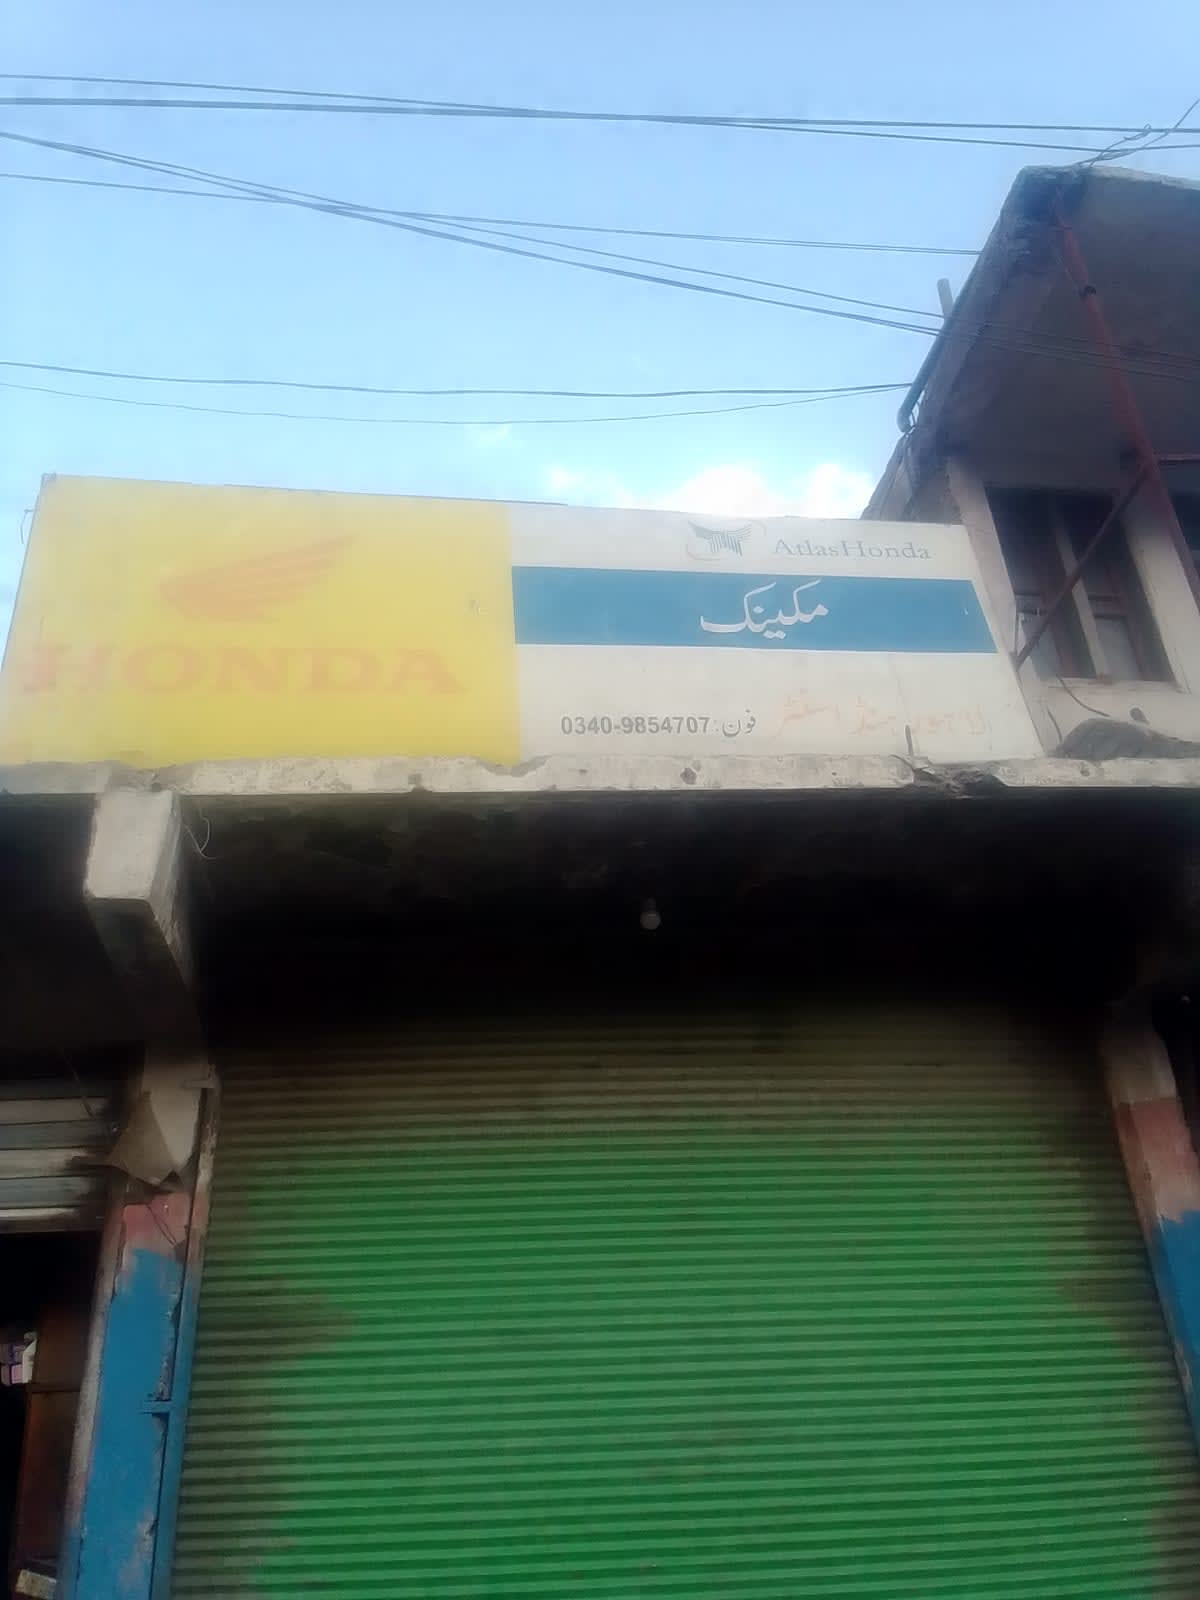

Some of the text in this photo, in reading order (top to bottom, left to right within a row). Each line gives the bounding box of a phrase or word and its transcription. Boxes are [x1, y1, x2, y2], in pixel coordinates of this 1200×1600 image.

[700, 578, 829, 639] مکینک
[22, 642, 467, 695] HONDA
[561, 716, 711, 735] 0340-9854707
